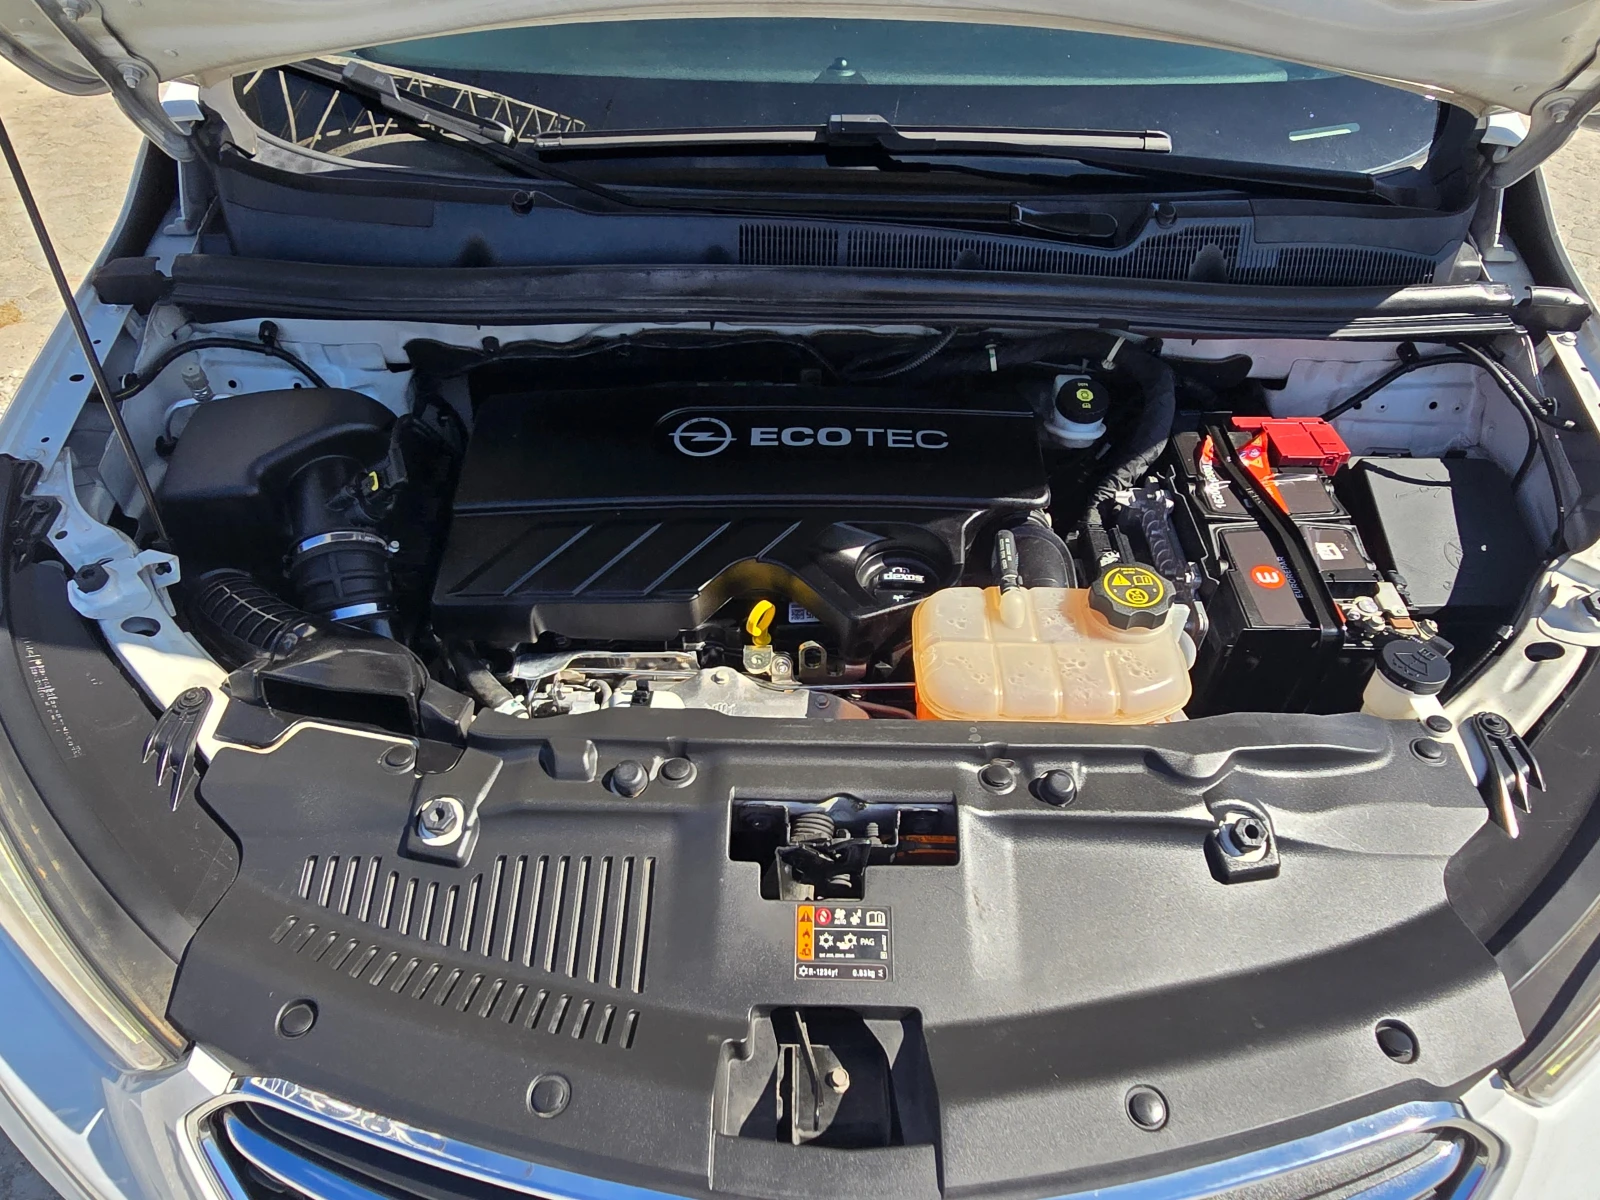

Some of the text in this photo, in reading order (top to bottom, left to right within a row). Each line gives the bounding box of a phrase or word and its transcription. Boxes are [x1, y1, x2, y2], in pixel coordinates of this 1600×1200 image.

[750, 427, 949, 449] ECOTEC
[1277, 556, 1304, 599] EUROREPAR
[860, 938, 875, 946] PAG
